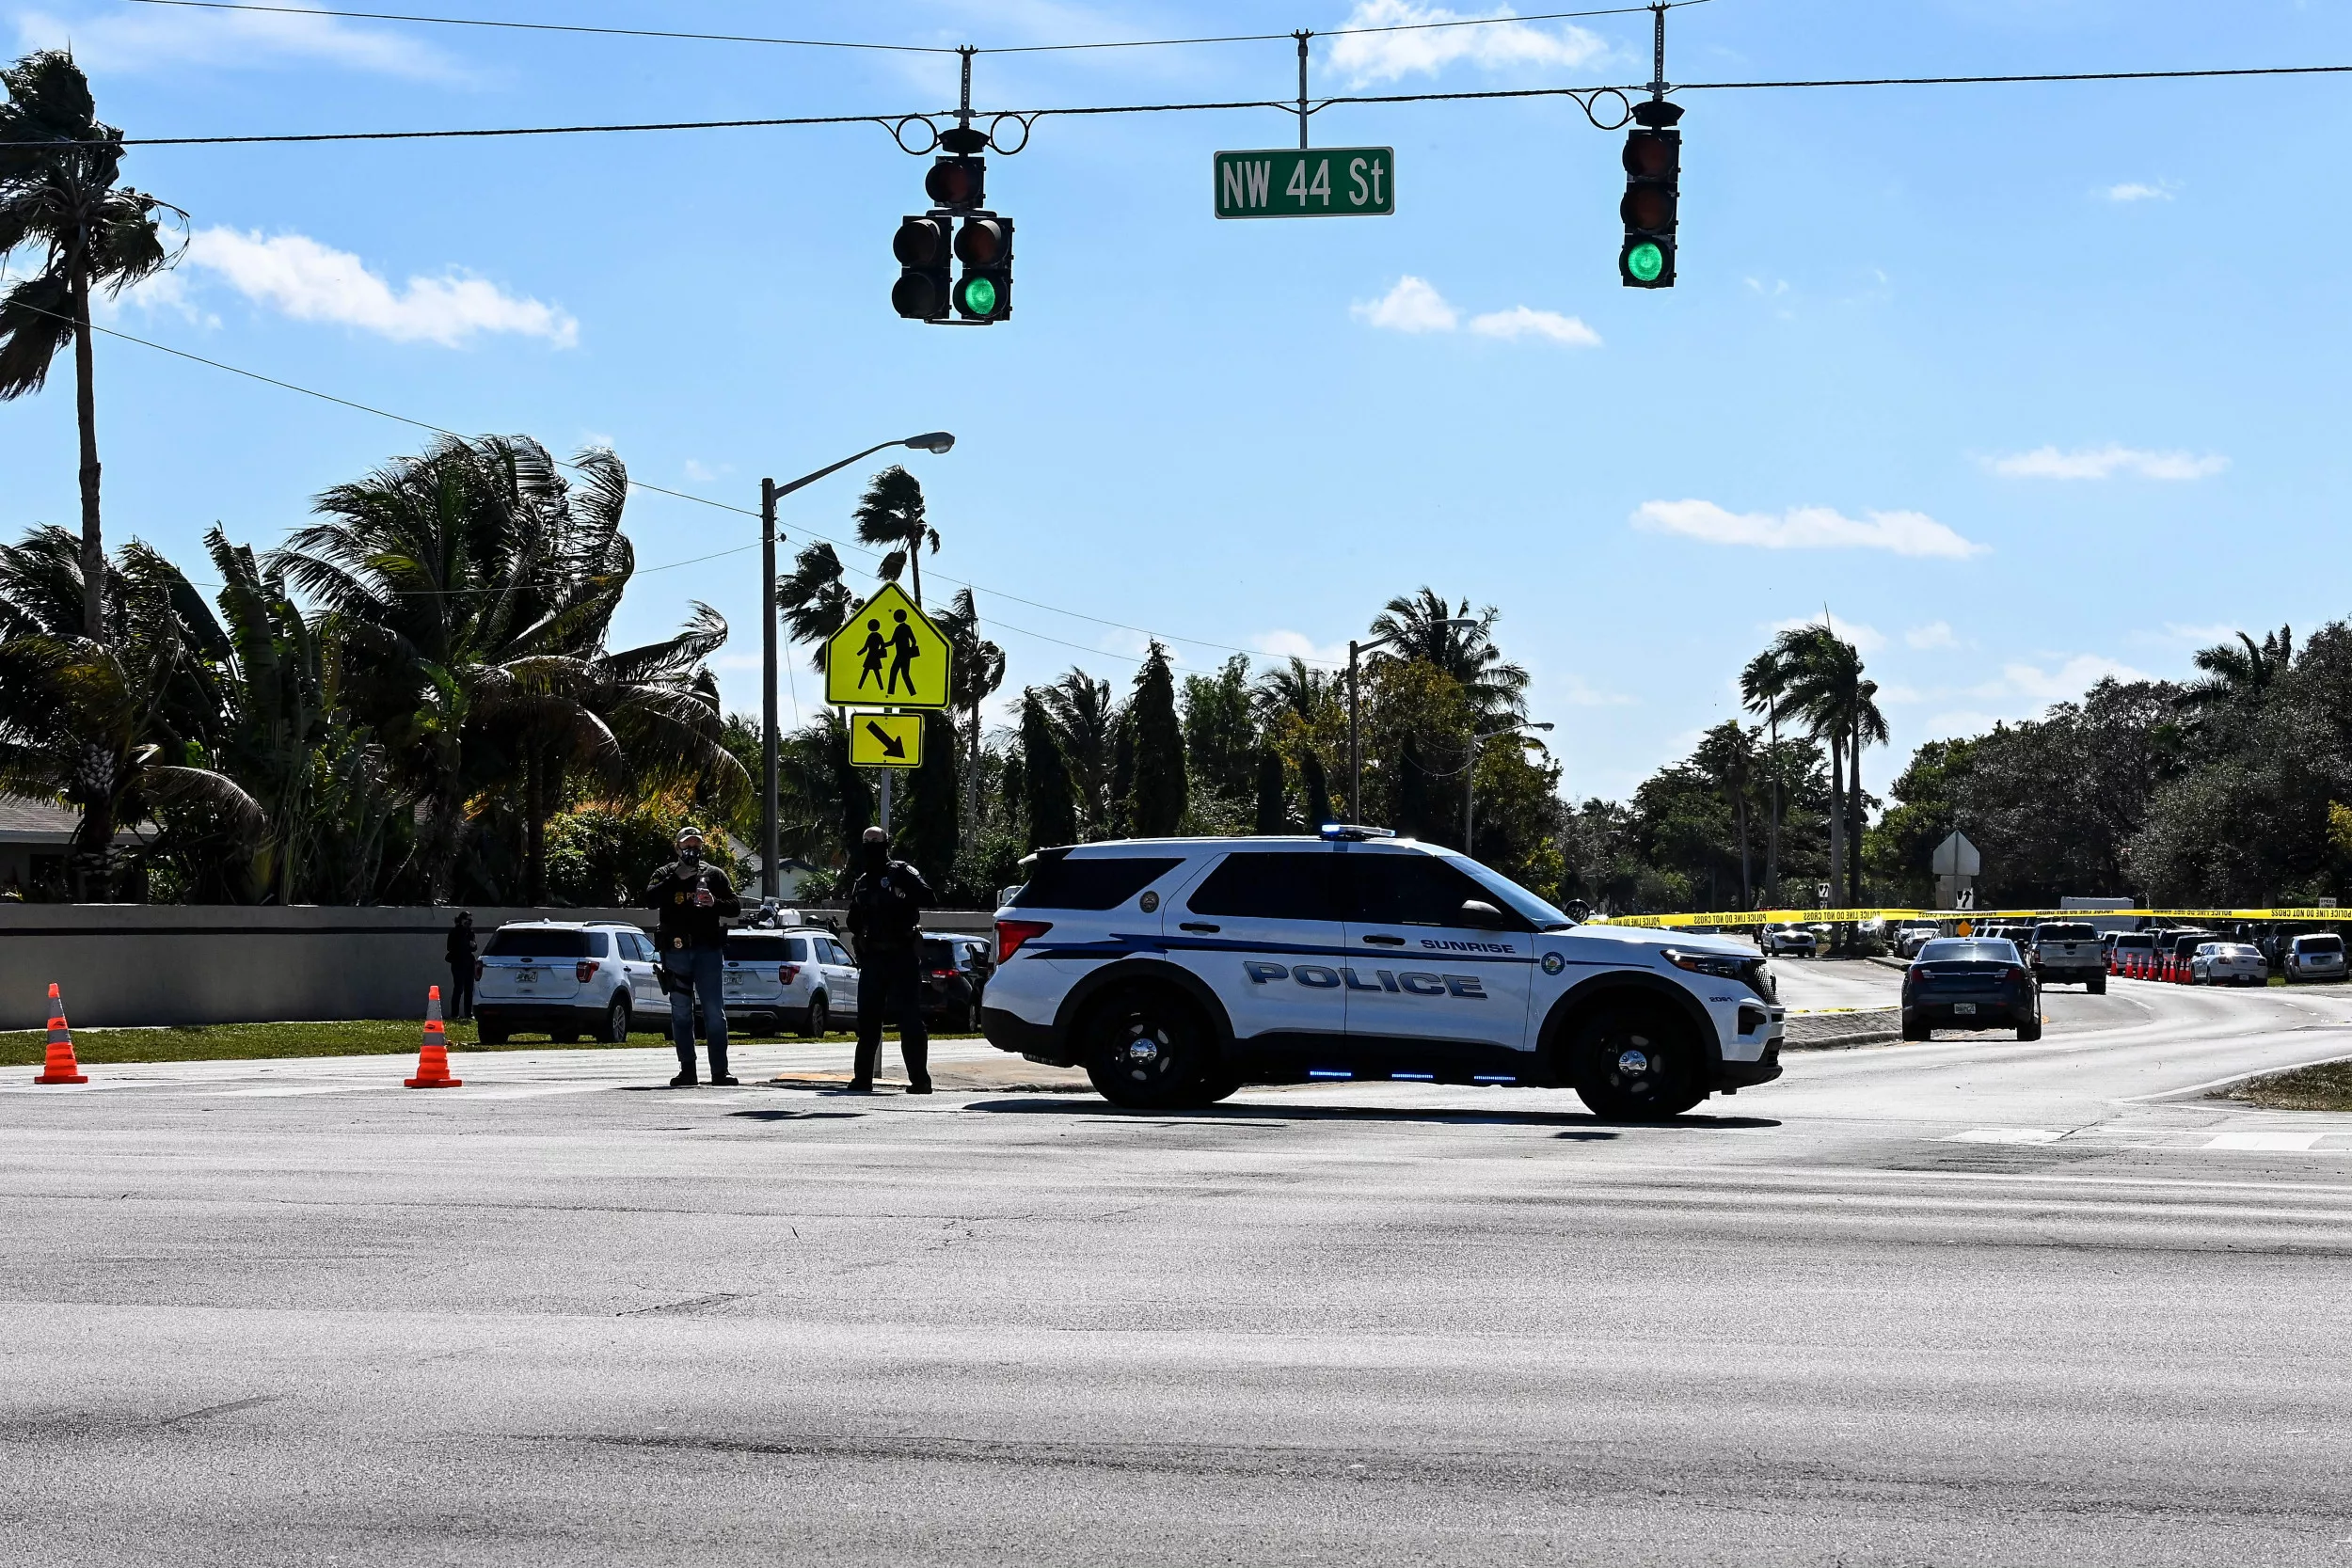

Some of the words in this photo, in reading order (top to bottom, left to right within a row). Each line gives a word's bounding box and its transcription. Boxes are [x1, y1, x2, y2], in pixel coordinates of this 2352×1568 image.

[1223, 160, 1271, 209] NW
[1286, 158, 1331, 206] 44
[1348, 157, 1384, 206] St
[2271, 909, 2291, 917] CROSS
[2316, 910, 2329, 918] LINE
[2330, 910, 2352, 918] POLICE
[1420, 939, 1516, 955] SUNRISE
[1243, 960, 1488, 1000] POLICE
